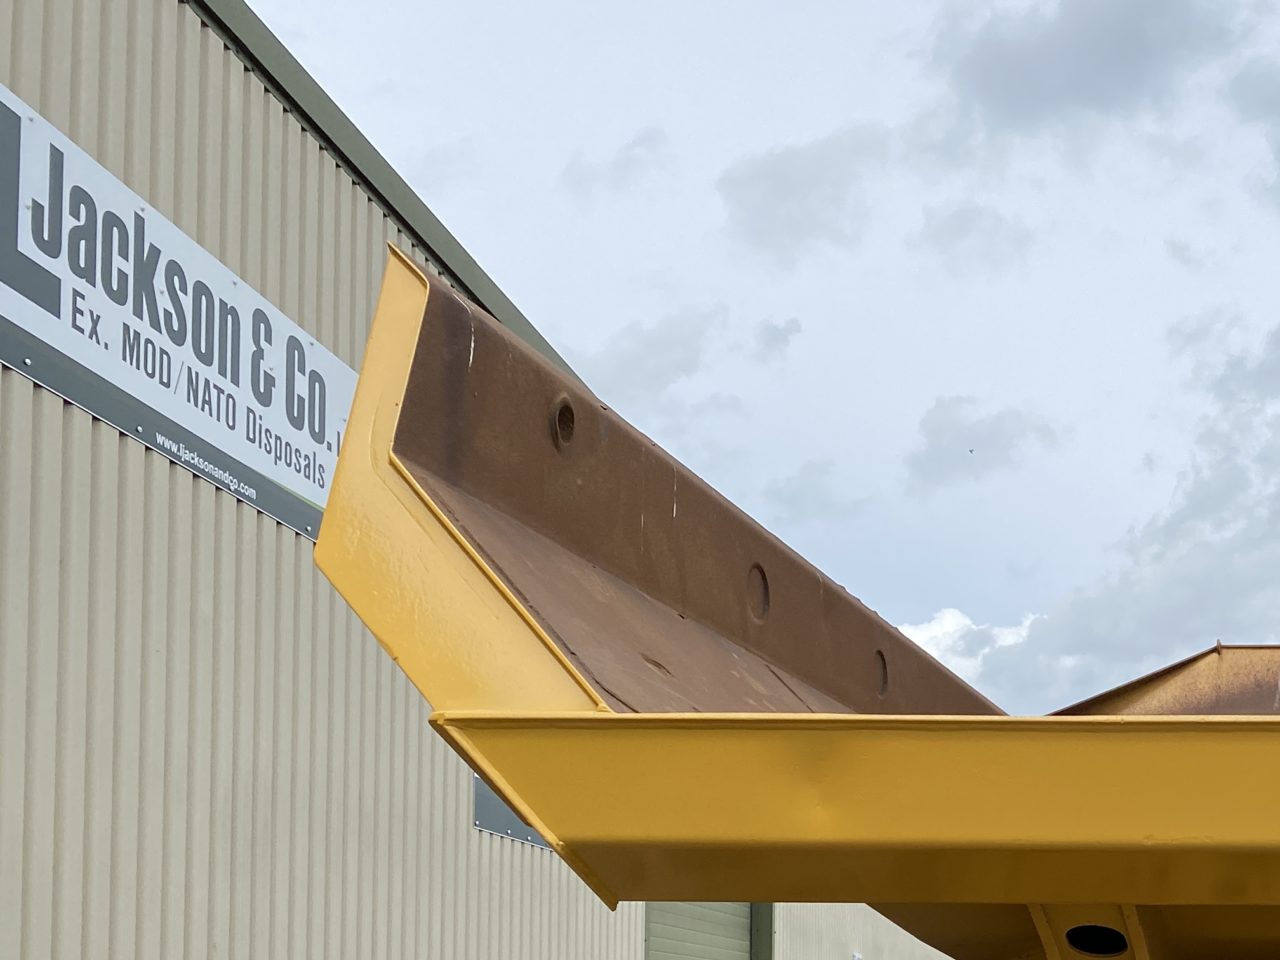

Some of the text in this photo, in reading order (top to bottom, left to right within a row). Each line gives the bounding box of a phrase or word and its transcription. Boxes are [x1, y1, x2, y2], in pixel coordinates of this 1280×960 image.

[30, 143, 240, 388] Jackson
[251, 308, 276, 408] &
[286, 335, 332, 452] Co.
[72, 287, 325, 488] Ex. MOD/NATO Disposals
